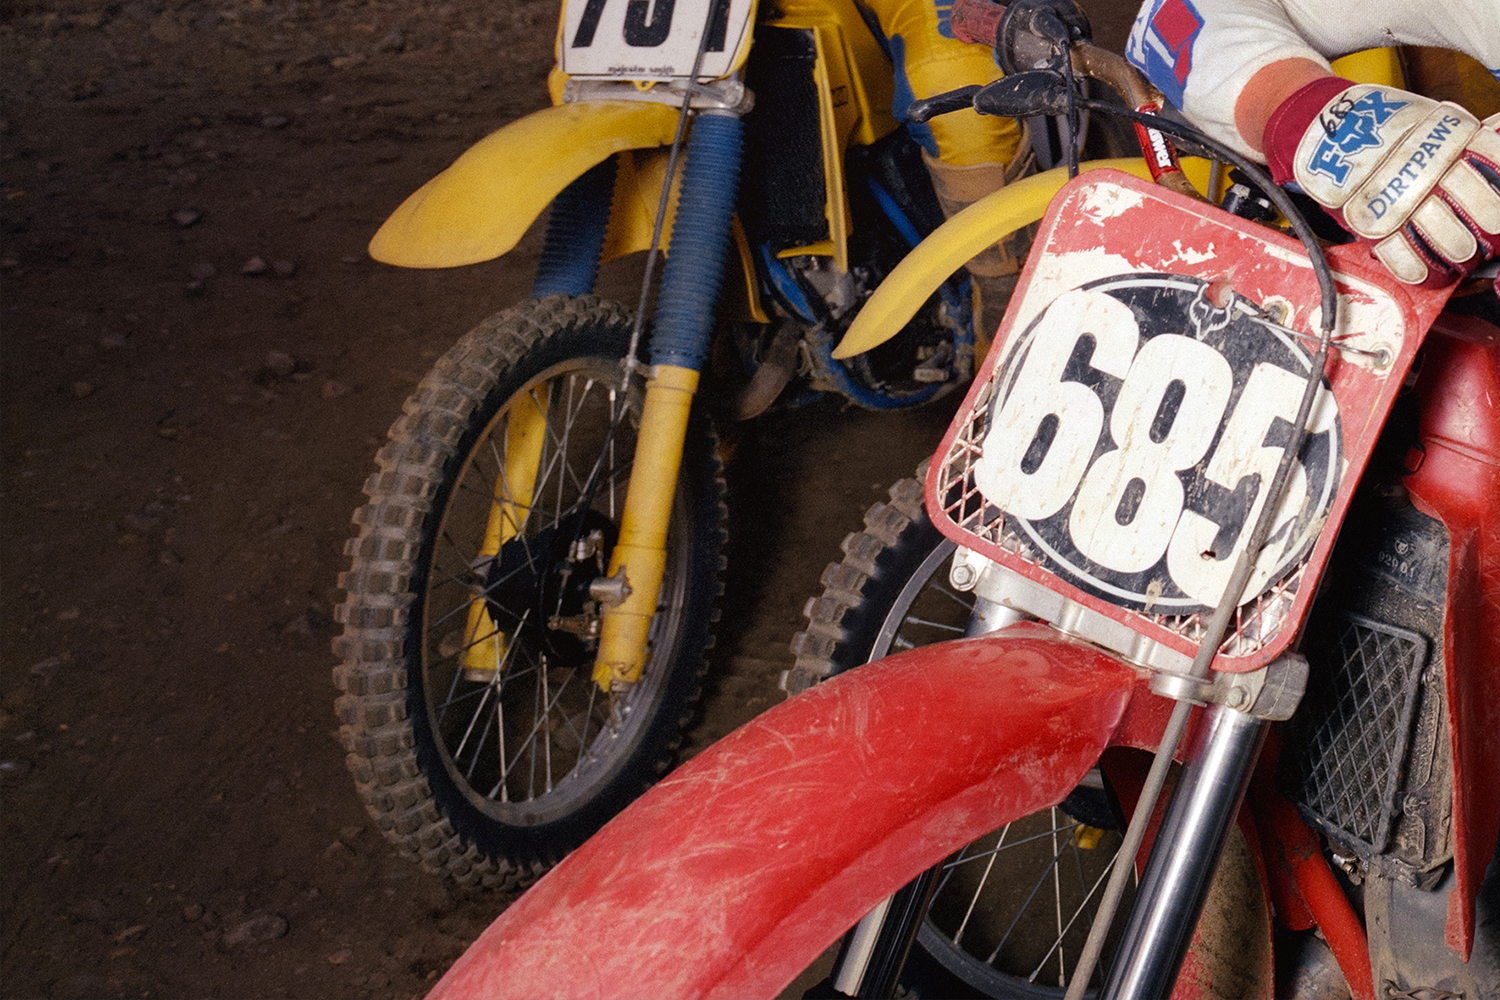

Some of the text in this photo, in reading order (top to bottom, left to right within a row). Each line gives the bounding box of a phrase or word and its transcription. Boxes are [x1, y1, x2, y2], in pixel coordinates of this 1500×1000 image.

[1307, 90, 1411, 186] FOX
[1319, 91, 1355, 138] 685
[1367, 113, 1462, 220] DIRTPAWS
[974, 290, 1338, 609] 685
